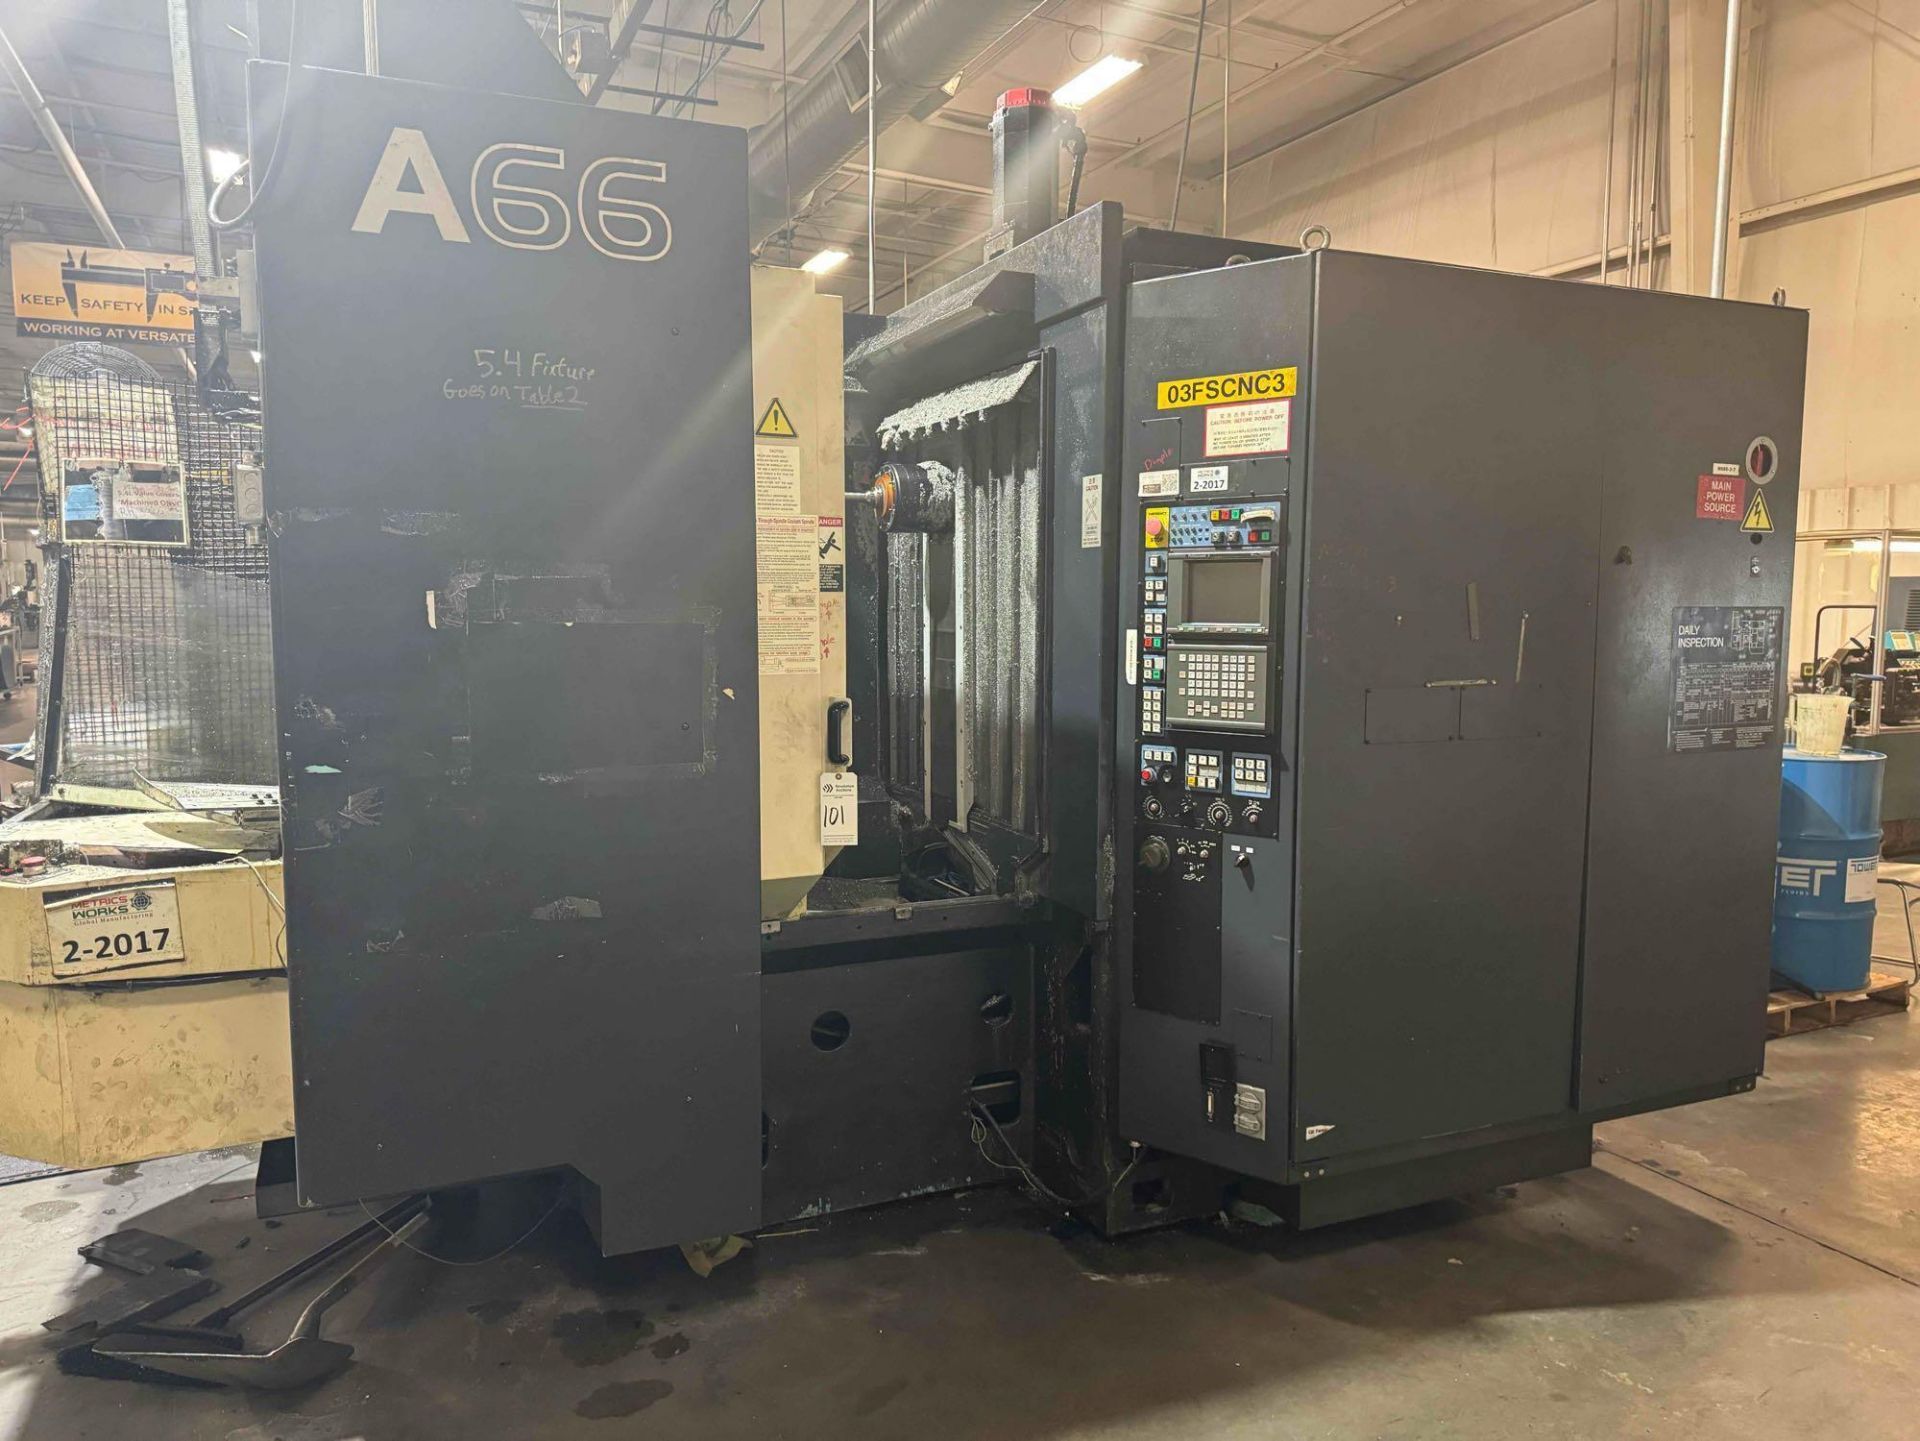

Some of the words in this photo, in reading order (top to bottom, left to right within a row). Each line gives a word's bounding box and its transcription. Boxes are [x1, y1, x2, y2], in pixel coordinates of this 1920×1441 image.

[351, 127, 672, 262] A66
[20, 293, 66, 306] KEEP
[81, 298, 144, 312] SAFETY
[158, 303, 174, 314] IN
[24, 322, 102, 337] WORKING
[106, 328, 125, 338] AT
[473, 349, 522, 379] 5.4
[531, 352, 596, 381] Fixture
[443, 378, 486, 400] Goes
[490, 385, 511, 400] on
[513, 385, 565, 406] Table
[1167, 373, 1286, 404] 03FSCNC3
[1193, 479, 1225, 490] 2-2017
[1711, 480, 1732, 491] MAIN
[1706, 491, 1736, 503] POWER
[1703, 502, 1737, 514] SOURCE
[818, 518, 842, 526] ANGER
[1678, 625, 1701, 636] DAILY
[1677, 637, 1724, 648] INSPECTION
[823, 804, 845, 828] 101
[71, 895, 128, 910] METRICS
[72, 905, 129, 920] WORKS
[73, 918, 99, 927] Global
[100, 911, 154, 923] Manufacturing
[62, 927, 170, 964] 2-2017
